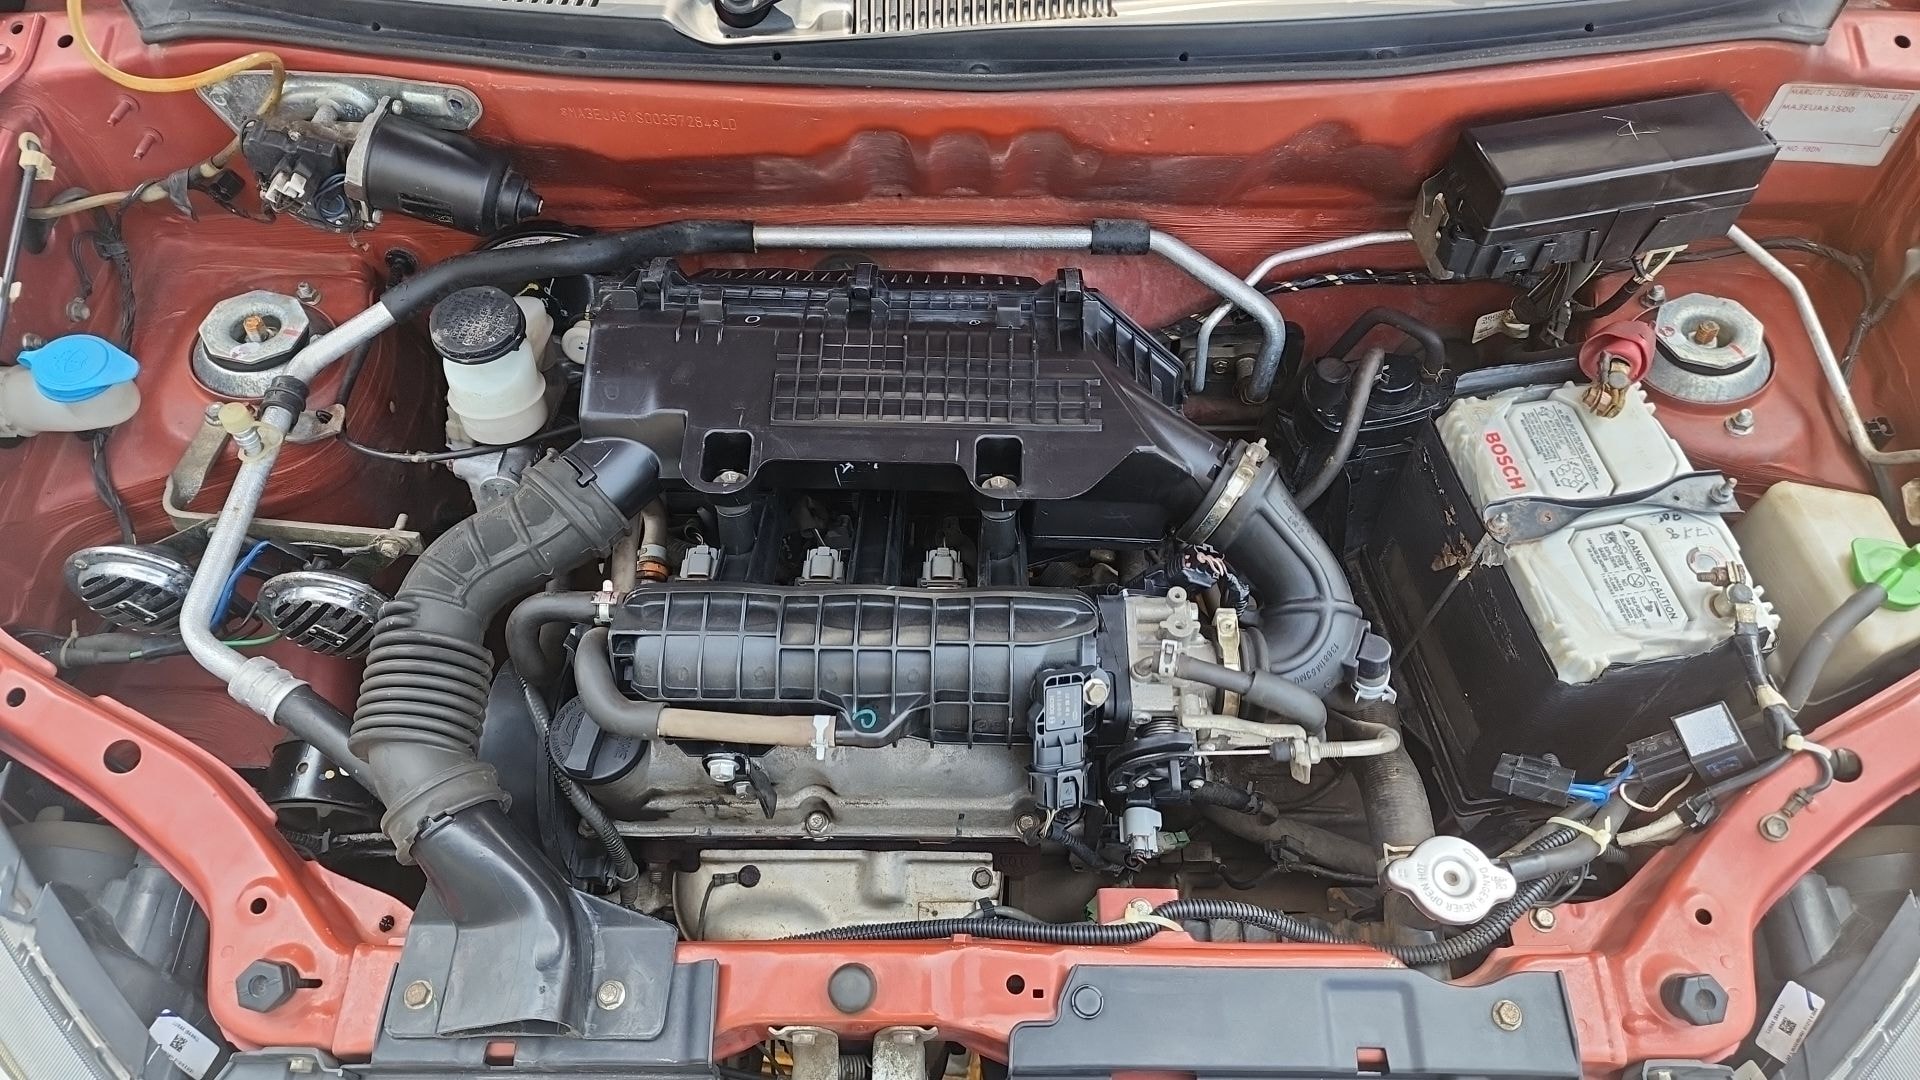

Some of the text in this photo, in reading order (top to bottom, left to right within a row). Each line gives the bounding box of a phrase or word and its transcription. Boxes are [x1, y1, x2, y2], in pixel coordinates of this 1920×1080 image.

[1791, 88, 1824, 96] MARUTI
[1826, 89, 1860, 98] SUZUKI
[1864, 90, 1889, 99] INDIA
[1485, 432, 1526, 490] BOSCH
[1627, 538, 1652, 573] DANGER
[1651, 580, 1678, 620] CAUTION
